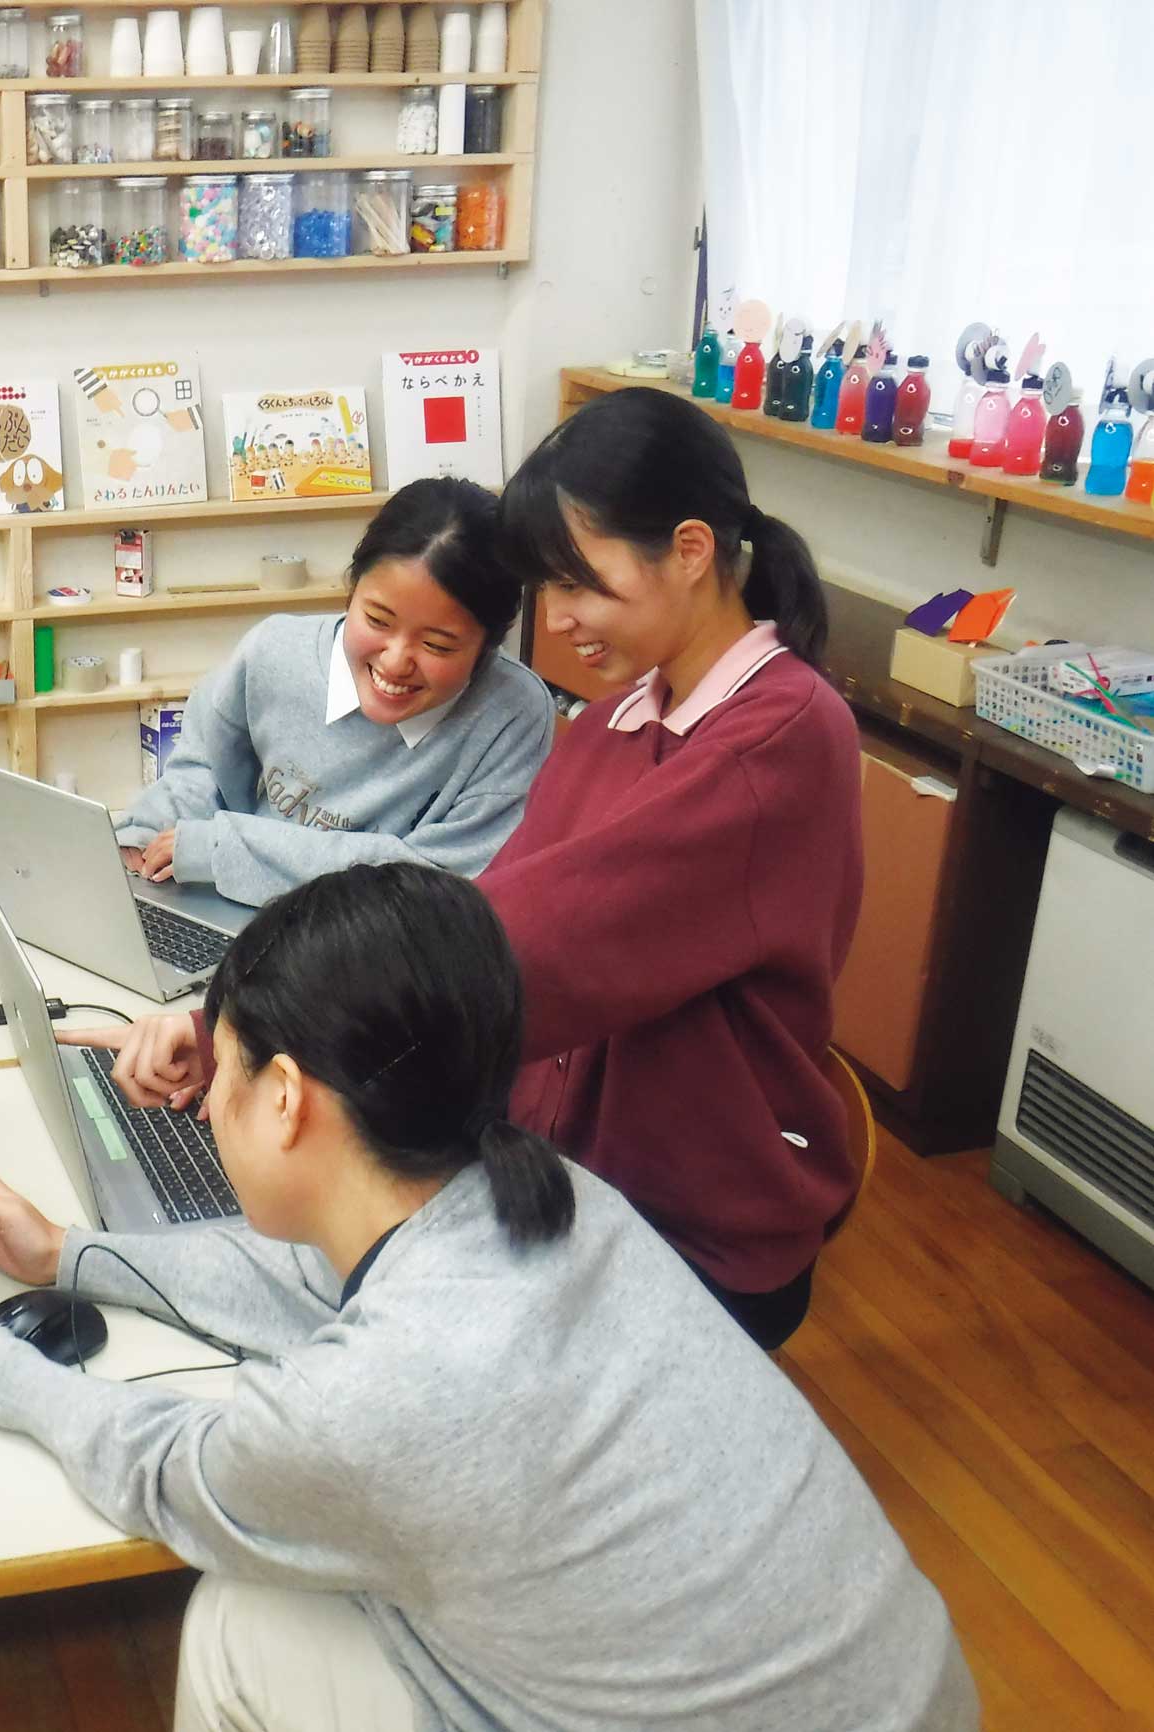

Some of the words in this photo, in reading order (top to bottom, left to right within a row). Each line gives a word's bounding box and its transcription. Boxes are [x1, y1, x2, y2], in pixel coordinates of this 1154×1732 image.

[402, 372, 484, 390] ならべかえ
[94, 487, 127, 502] さわる
[132, 482, 200, 499] たんけんたい
